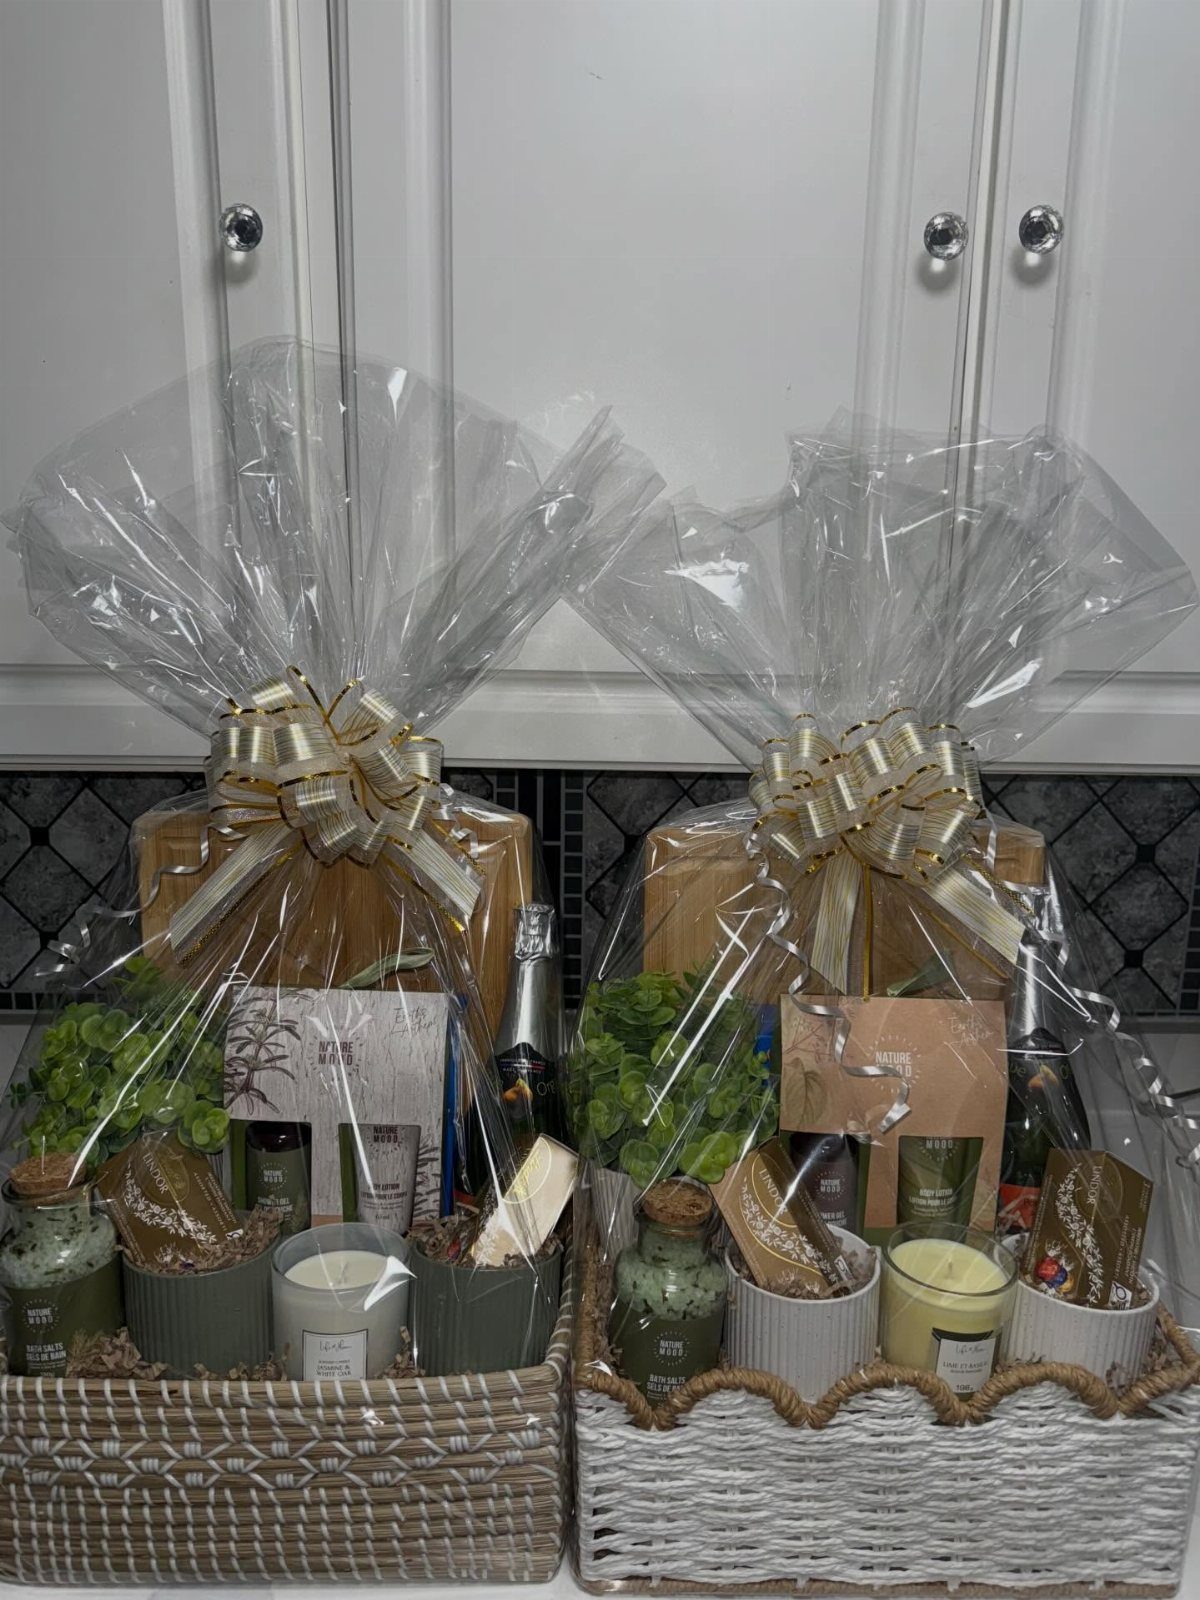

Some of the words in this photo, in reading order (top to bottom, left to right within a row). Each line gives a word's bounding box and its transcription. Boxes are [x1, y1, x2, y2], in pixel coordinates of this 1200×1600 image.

[875, 1051, 912, 1065] NATURE
[373, 1126, 398, 1134] NATURE
[373, 1135, 398, 1143] MOOD
[926, 1139, 952, 1149] MOOD
[142, 1151, 168, 1194] LINDOR
[1086, 1165, 1104, 1204] LINDOR
[27, 1308, 52, 1317] NATURE
[28, 1316, 53, 1325] MOOD
[27, 1344, 42, 1353] BATH
[43, 1342, 64, 1352] SALTS
[660, 1340, 684, 1349] NATURE
[41, 1353, 49, 1361] DE
[50, 1350, 67, 1360] BAIN
[659, 1348, 683, 1357] MOOD
[649, 1373, 667, 1383] BATH
[667, 1376, 686, 1385] SALTS
[647, 1381, 662, 1390] SELS
[663, 1383, 671, 1392] DE
